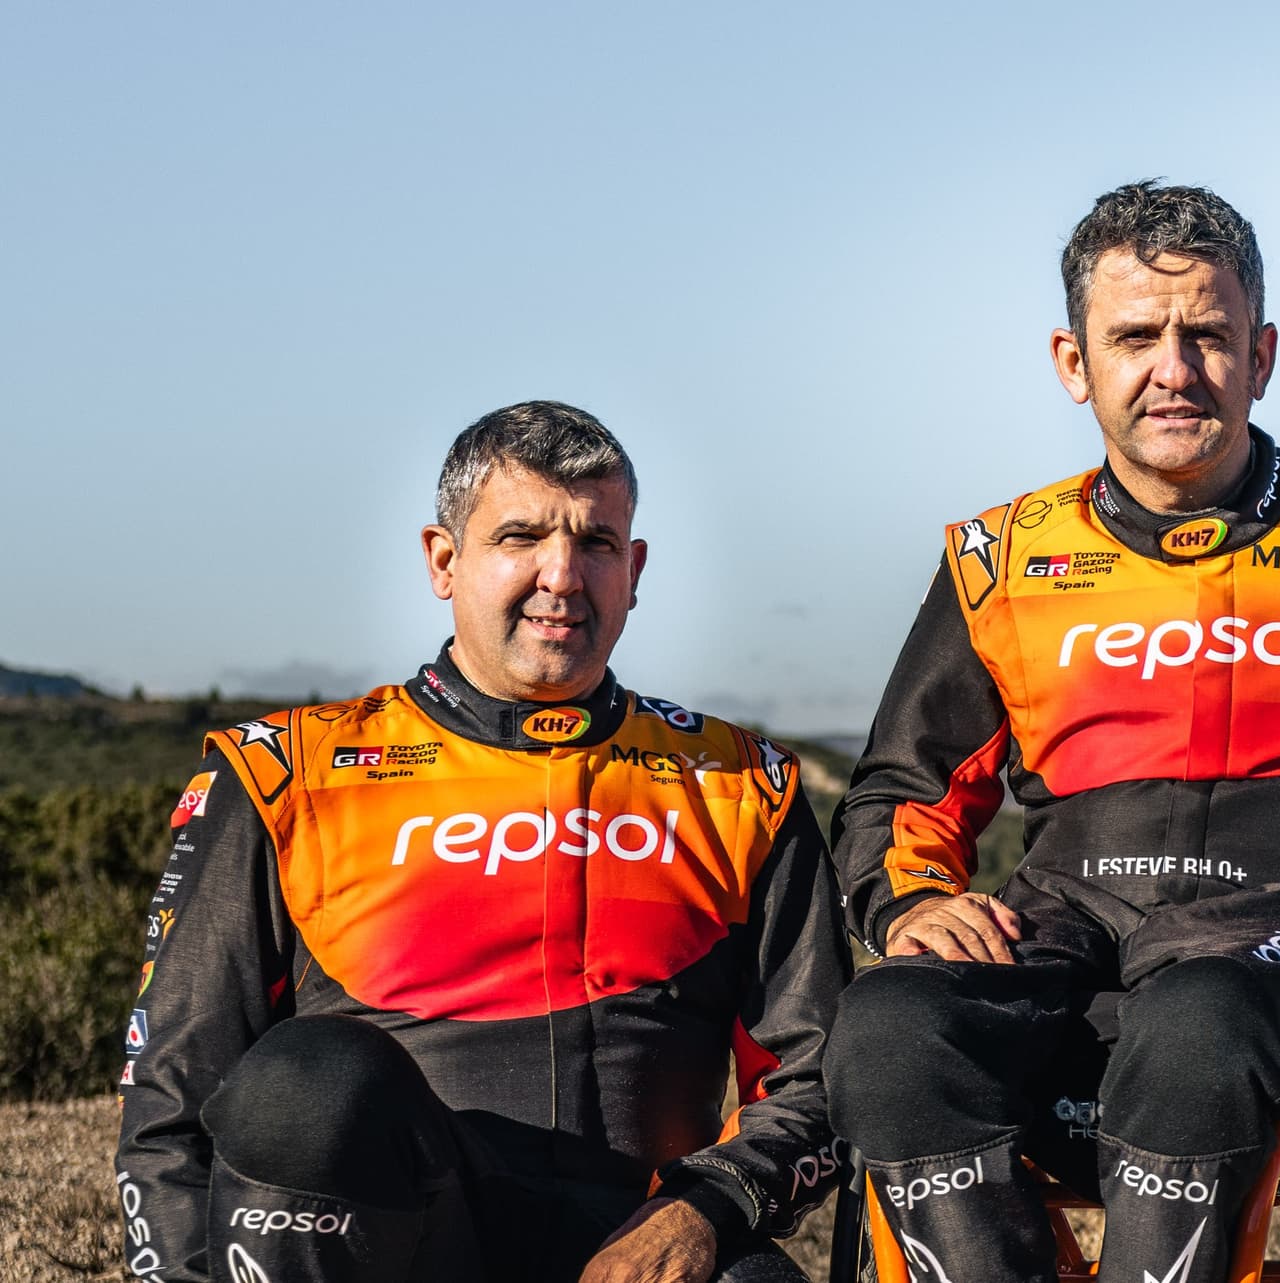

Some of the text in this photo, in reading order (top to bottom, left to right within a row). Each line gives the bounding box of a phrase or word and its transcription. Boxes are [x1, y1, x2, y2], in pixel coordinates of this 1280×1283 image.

[1073, 551, 1121, 560] TOYOTA
[1073, 558, 1115, 568] GAZOO
[1026, 562, 1069, 577] GR
[1072, 565, 1113, 576] Racing
[1053, 580, 1096, 591] Spain
[387, 741, 444, 753] TOYOTA
[387, 748, 438, 759] GAZOO
[610, 743, 684, 774] MGS
[333, 752, 382, 768] GR
[386, 756, 437, 766] Racing
[366, 769, 414, 781] Spain
[391, 807, 680, 876] repsol
[1098, 855, 1177, 876] ESTEVE
[1184, 857, 1212, 876] RH
[1114, 1159, 1219, 1206] repsol
[229, 1207, 352, 1236] repsol
